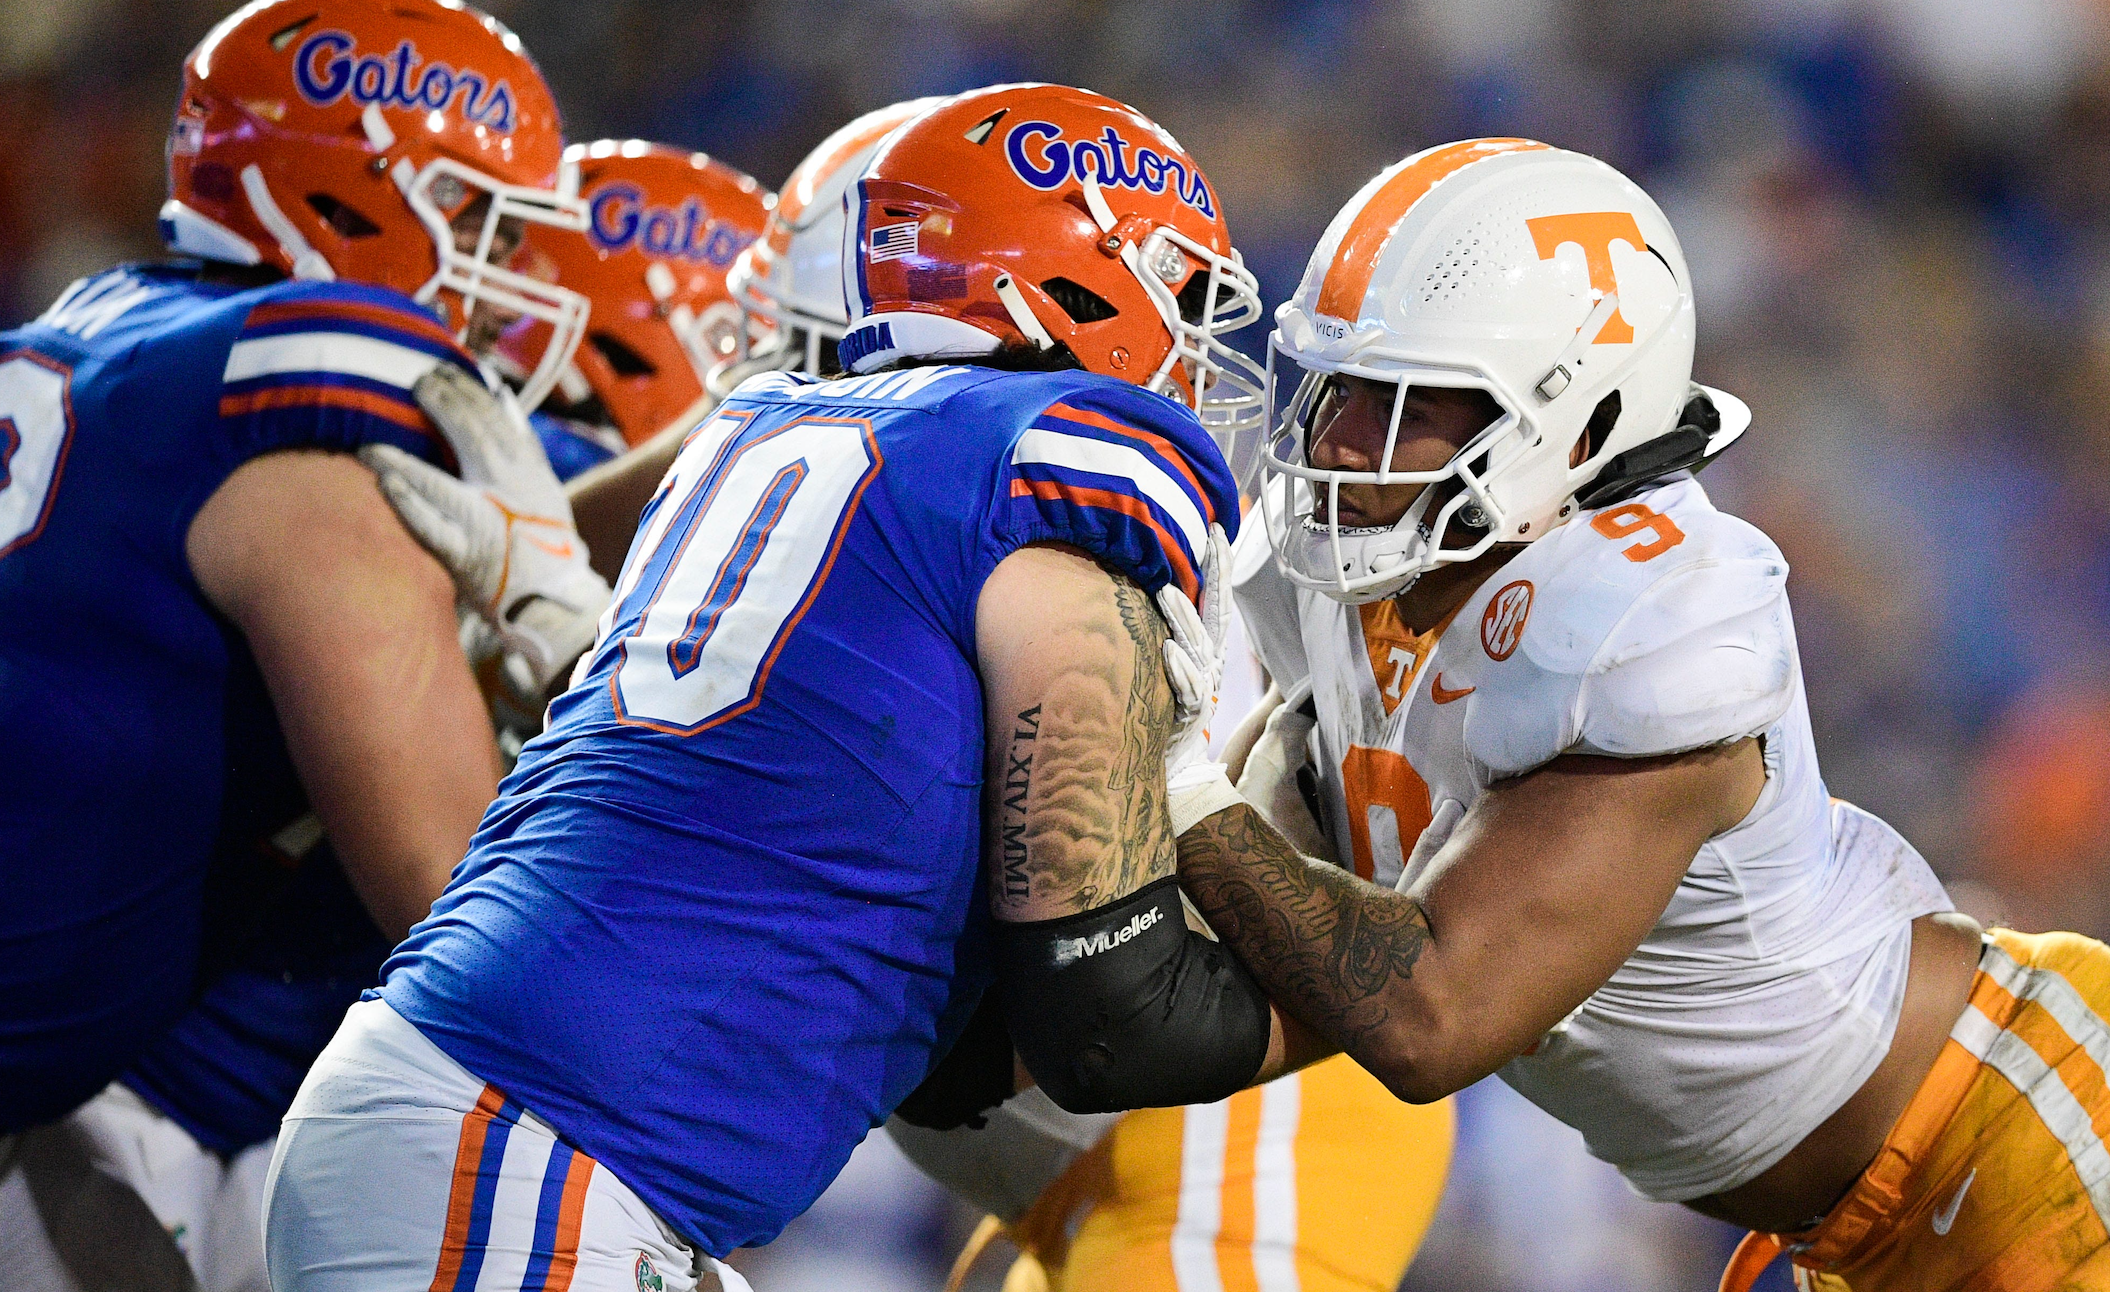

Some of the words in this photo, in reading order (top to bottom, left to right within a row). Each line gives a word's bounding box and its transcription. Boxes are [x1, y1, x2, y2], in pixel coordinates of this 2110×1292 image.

[294, 29, 516, 133] Gators
[1004, 120, 1216, 224] Gators
[590, 181, 755, 268] Gato
[1525, 212, 1648, 345] T
[1315, 321, 1344, 339] VICIS
[1589, 503, 1687, 563] 9
[1386, 646, 1417, 699] T
